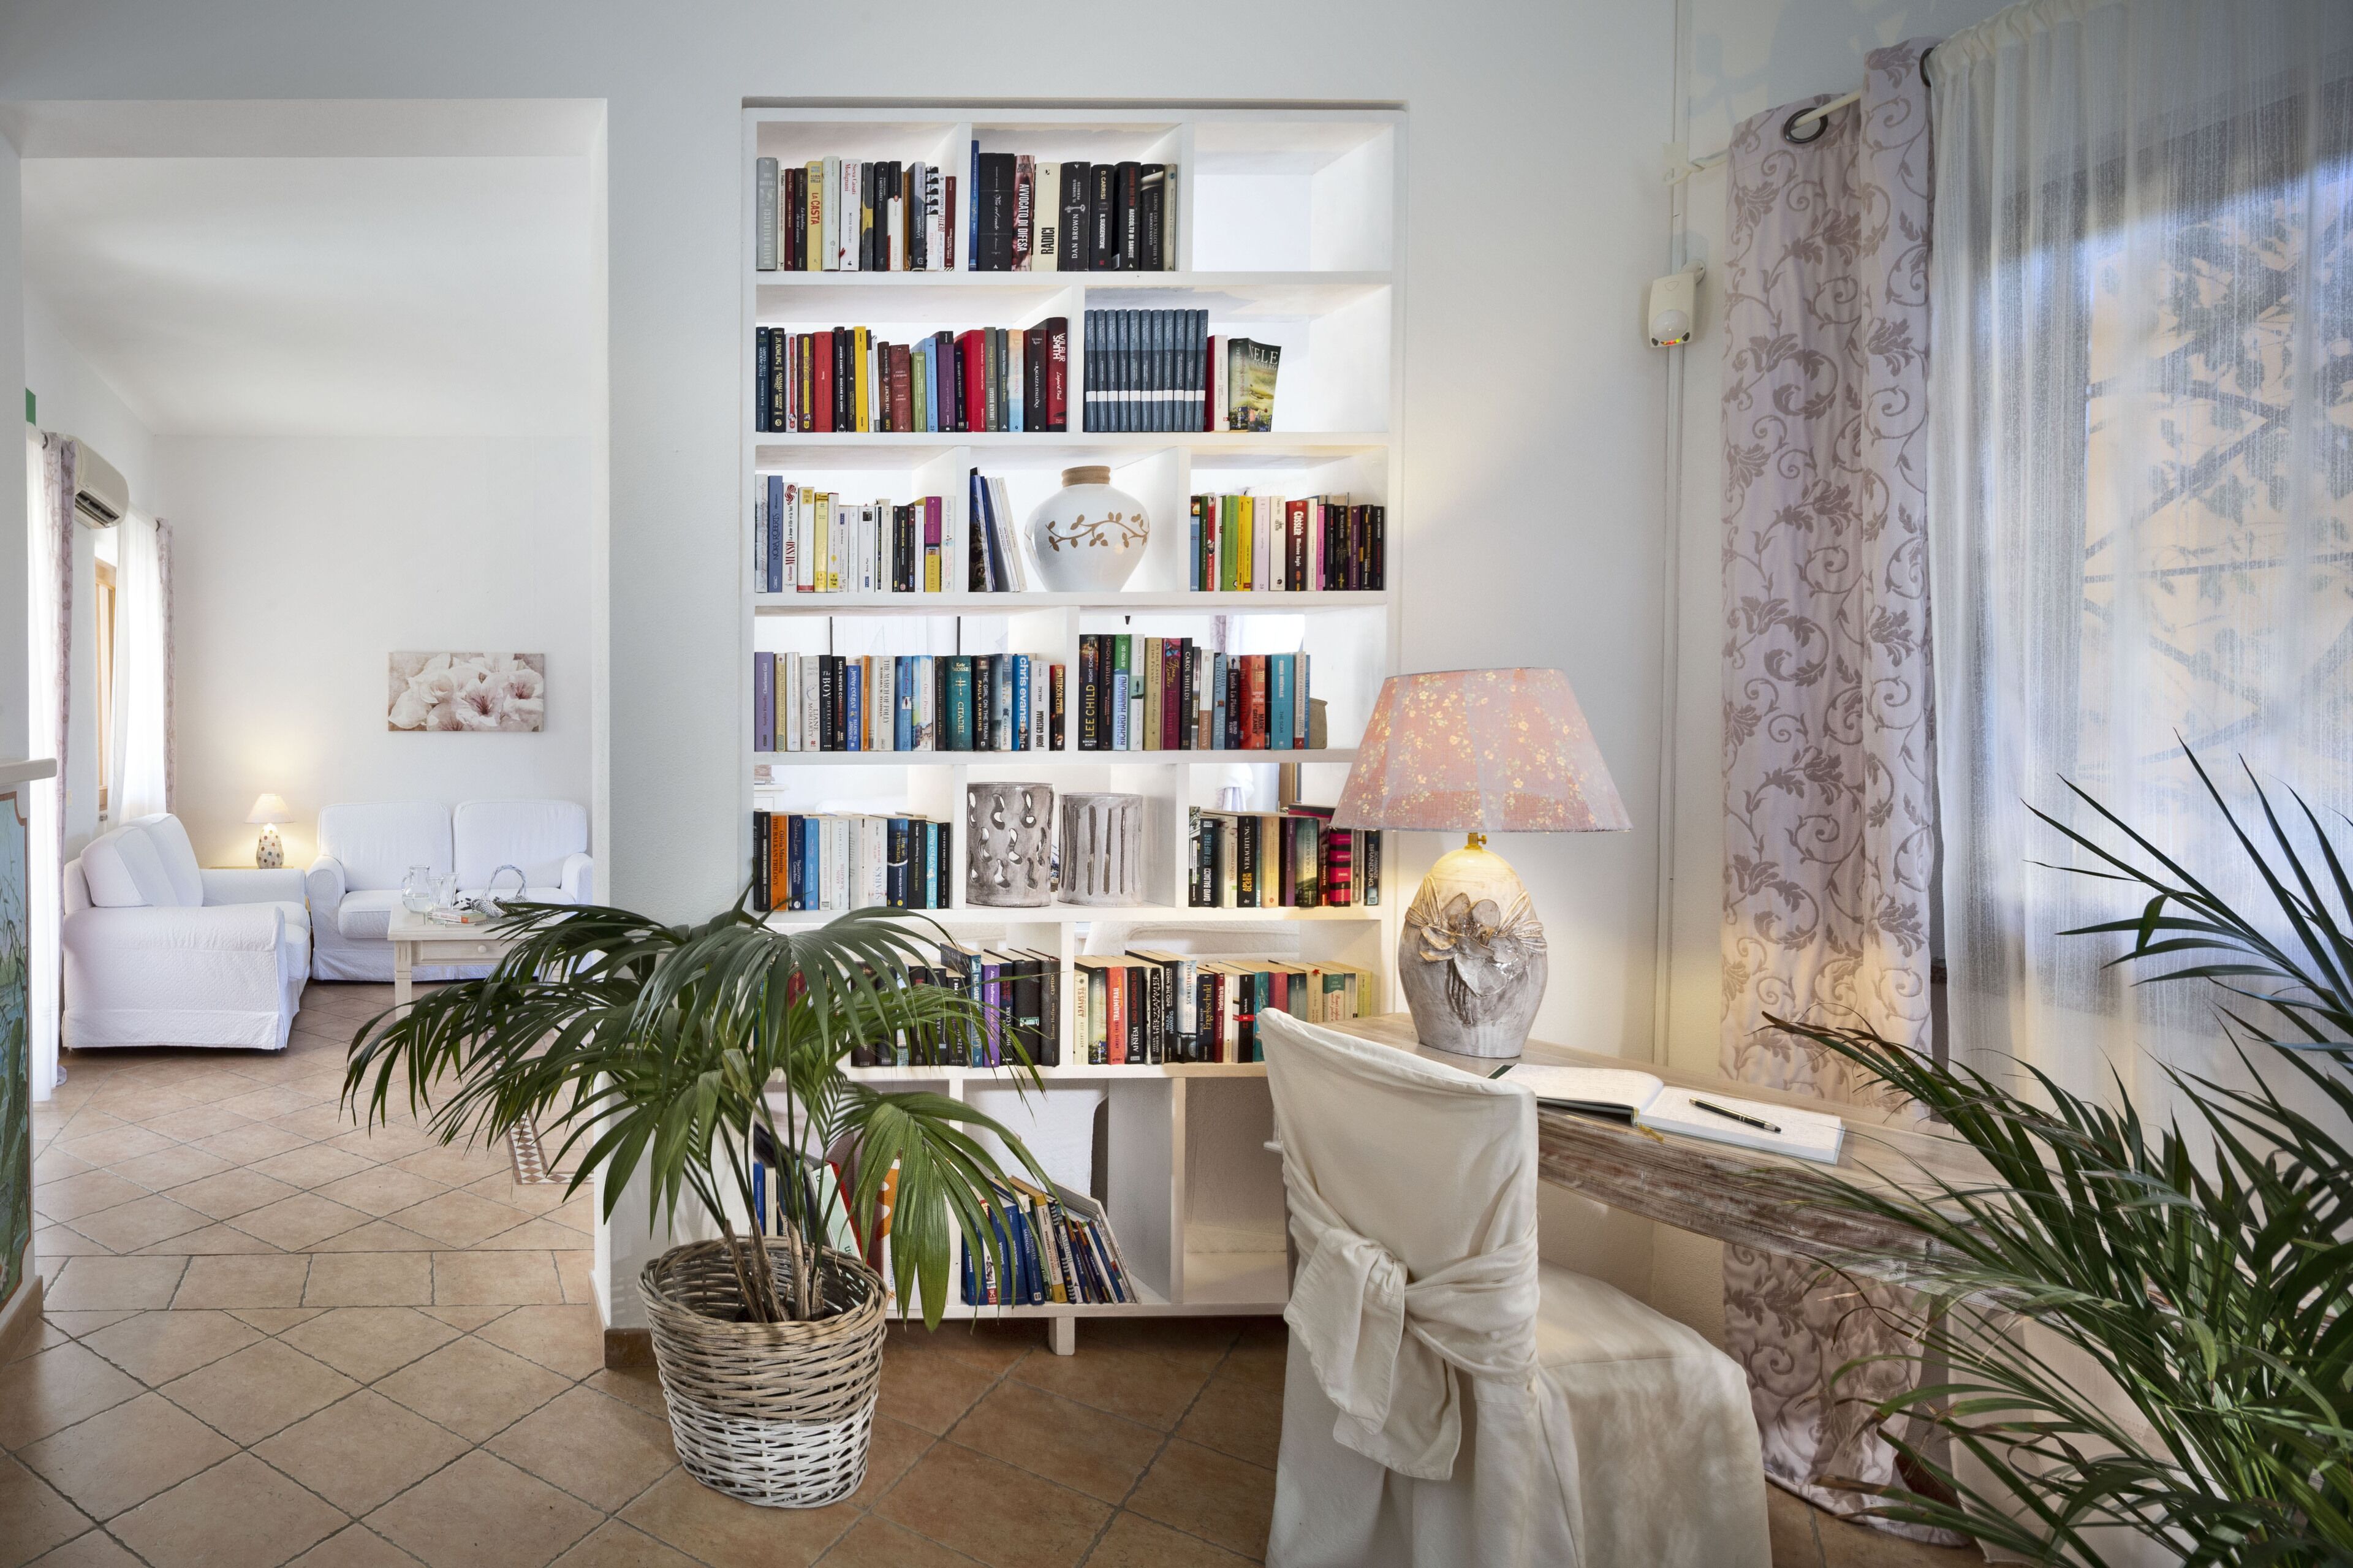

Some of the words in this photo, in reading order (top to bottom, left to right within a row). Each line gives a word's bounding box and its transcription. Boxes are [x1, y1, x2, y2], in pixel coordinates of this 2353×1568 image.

[811, 200, 820, 225] CASTA
[1018, 184, 1029, 218] AVVOCATO
[1017, 228, 1028, 251] DIFESA
[1041, 227, 1055, 254] RADICI
[1247, 346, 1279, 365] NELE
[771, 513, 780, 540] ROBERTS
[1293, 511, 1304, 536] CUSSLER
[771, 540, 780, 560] NORA
[1019, 657, 1028, 686] chris
[983, 699, 988, 708] ON
[1085, 684, 1095, 716] CHILD
[1117, 676, 1127, 713] HAMMOND
[1036, 710, 1045, 733] GRISHAM
[1085, 718, 1095, 737] LEE
[1117, 714, 1127, 746] RICHARD
[1036, 735, 1045, 748] JOHN
[1131, 971, 1137, 980] DU
[1152, 974, 1161, 1034] HERZSAMMLER
[1203, 984, 1214, 1030] Engelsschuld
